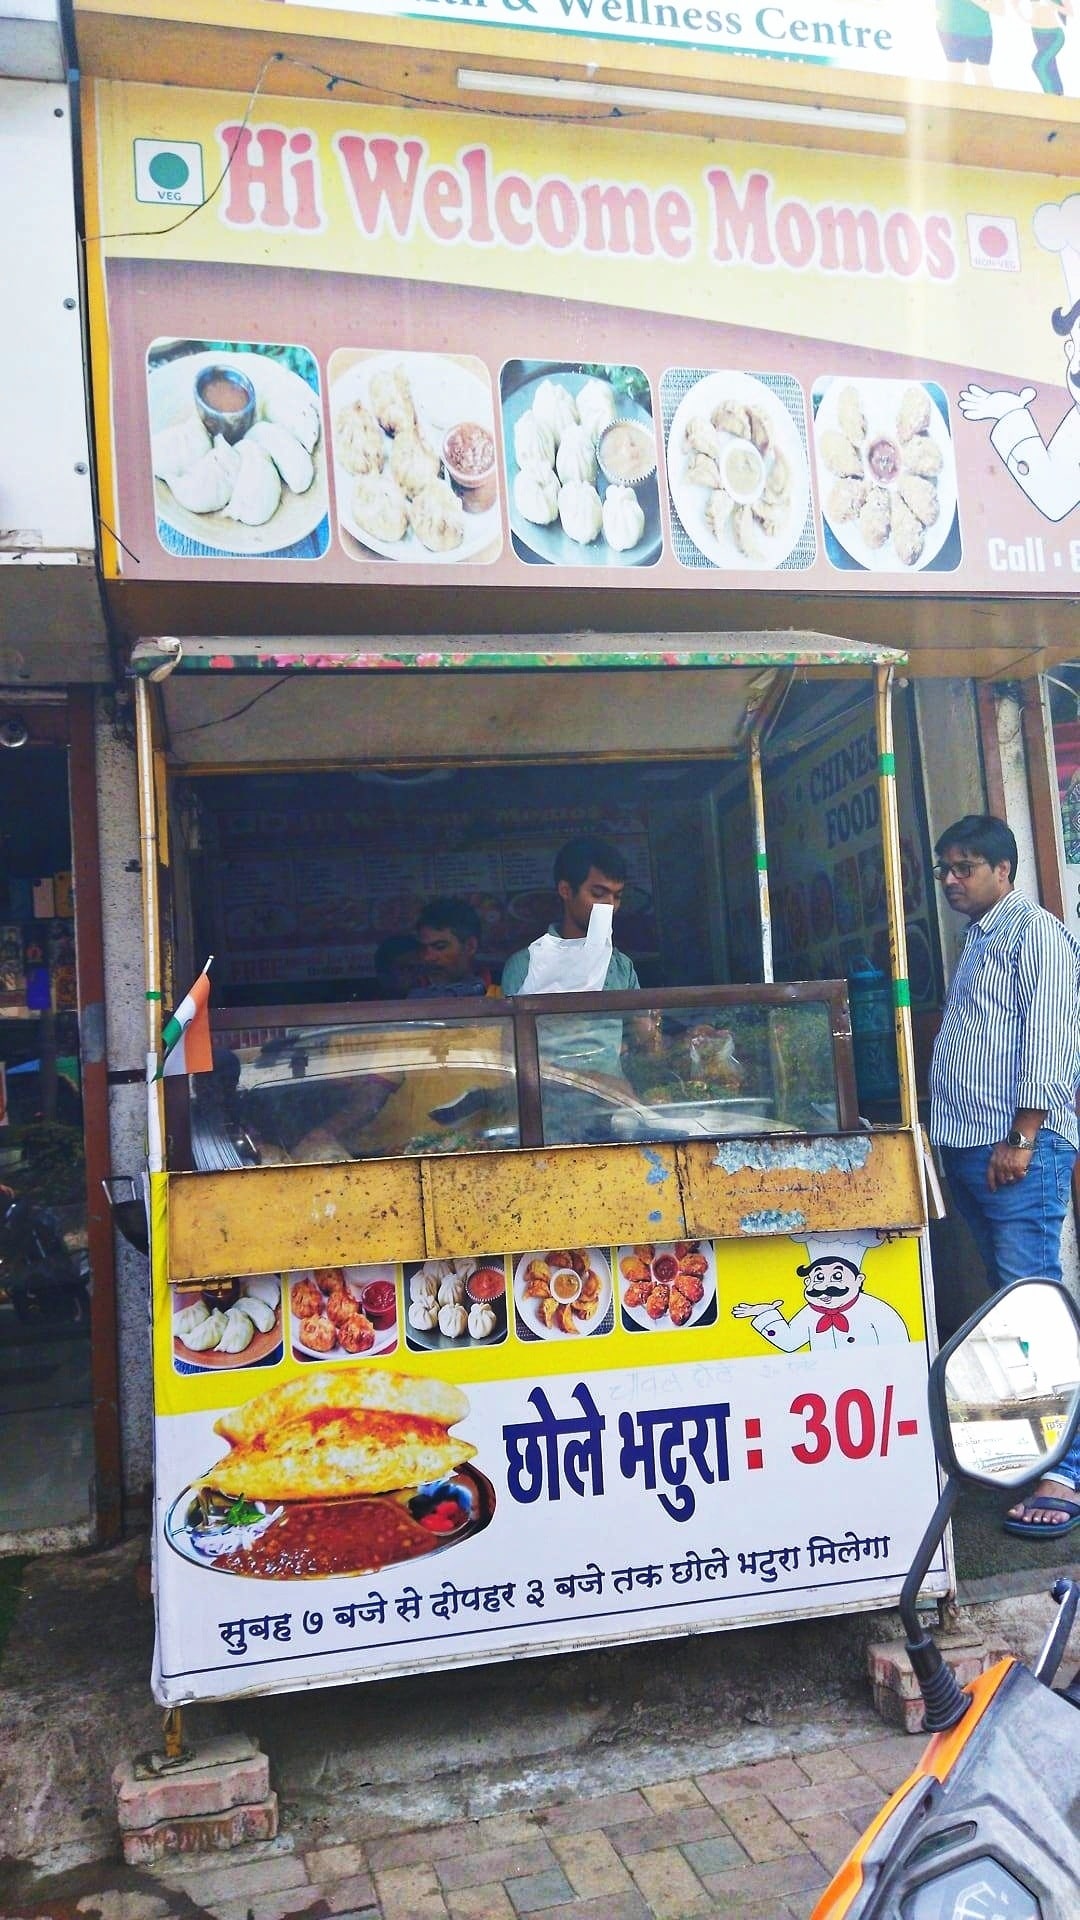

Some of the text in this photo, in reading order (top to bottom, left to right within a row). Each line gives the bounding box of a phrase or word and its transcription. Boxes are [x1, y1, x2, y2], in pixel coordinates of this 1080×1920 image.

[755, 6, 893, 50] Centre
[157, 191, 182, 201] VEG
[220, 125, 956, 280] Hi Welcome Momos
[988, 537, 1045, 572] Call
[826, 784, 880, 849] FOOD
[502, 1381, 606, 1504] छोले
[618, 1402, 732, 1523] भटुरा
[790, 1384, 918, 1465] 30/-
[219, 1531, 891, 1655] सुबह ७ बजे से दोपहर ३ बजे तक छोले भटुरा मिलेगा
